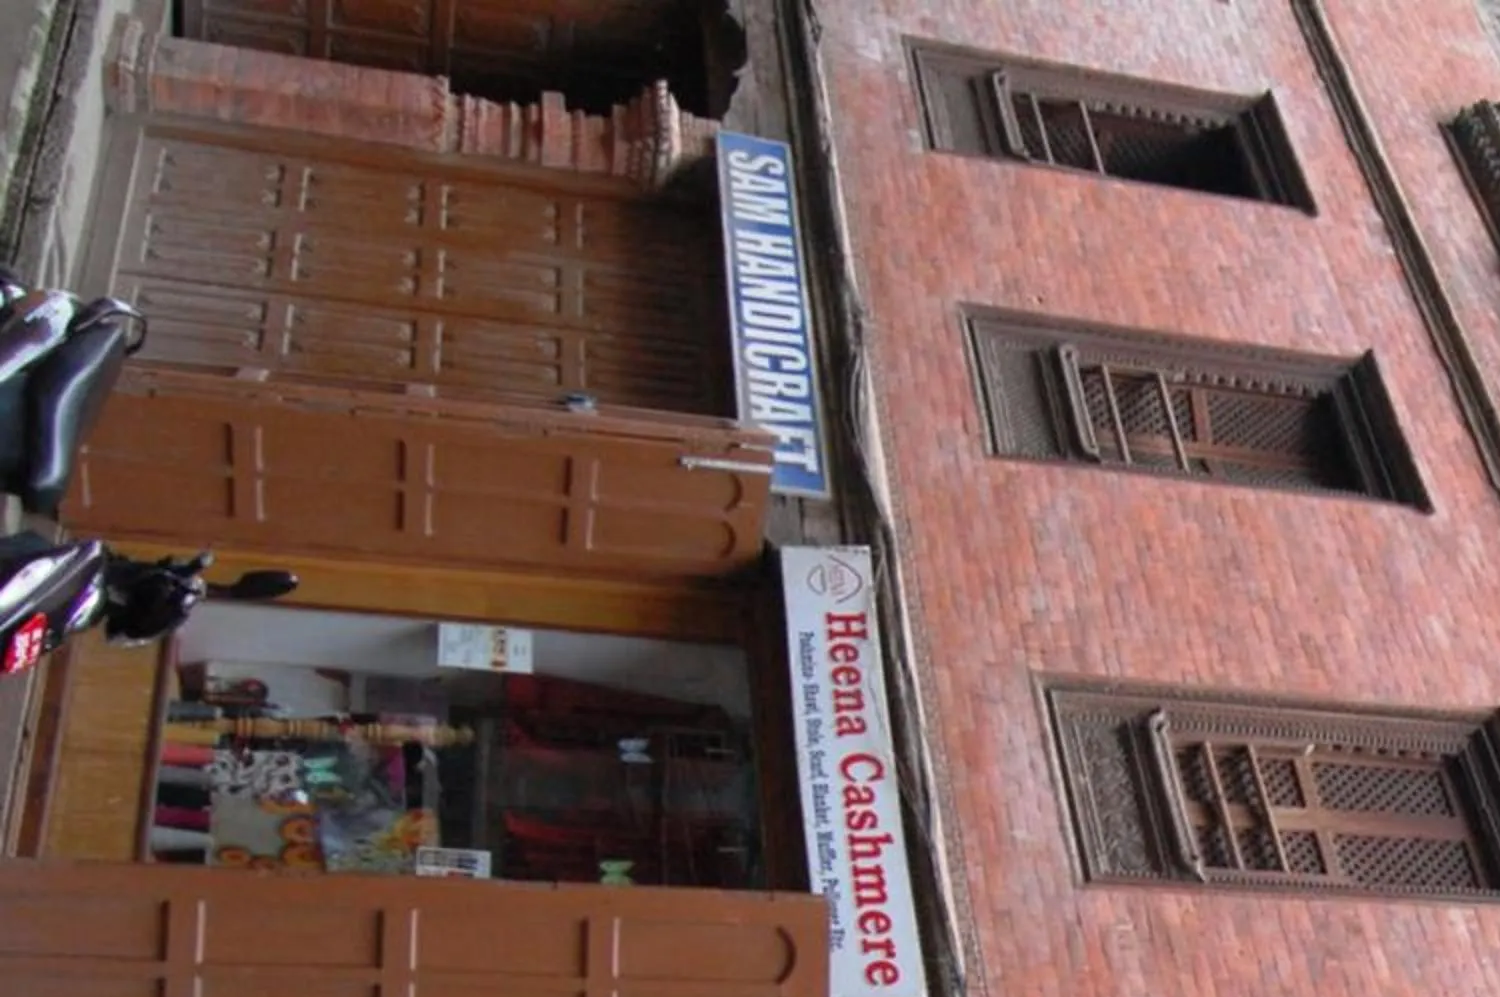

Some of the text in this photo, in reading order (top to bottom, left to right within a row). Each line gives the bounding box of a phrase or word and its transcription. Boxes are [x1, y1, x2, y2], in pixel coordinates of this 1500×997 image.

[727, 150, 820, 475] SAM HANDICRAFT
[825, 611, 901, 988] Heena Cashmere
